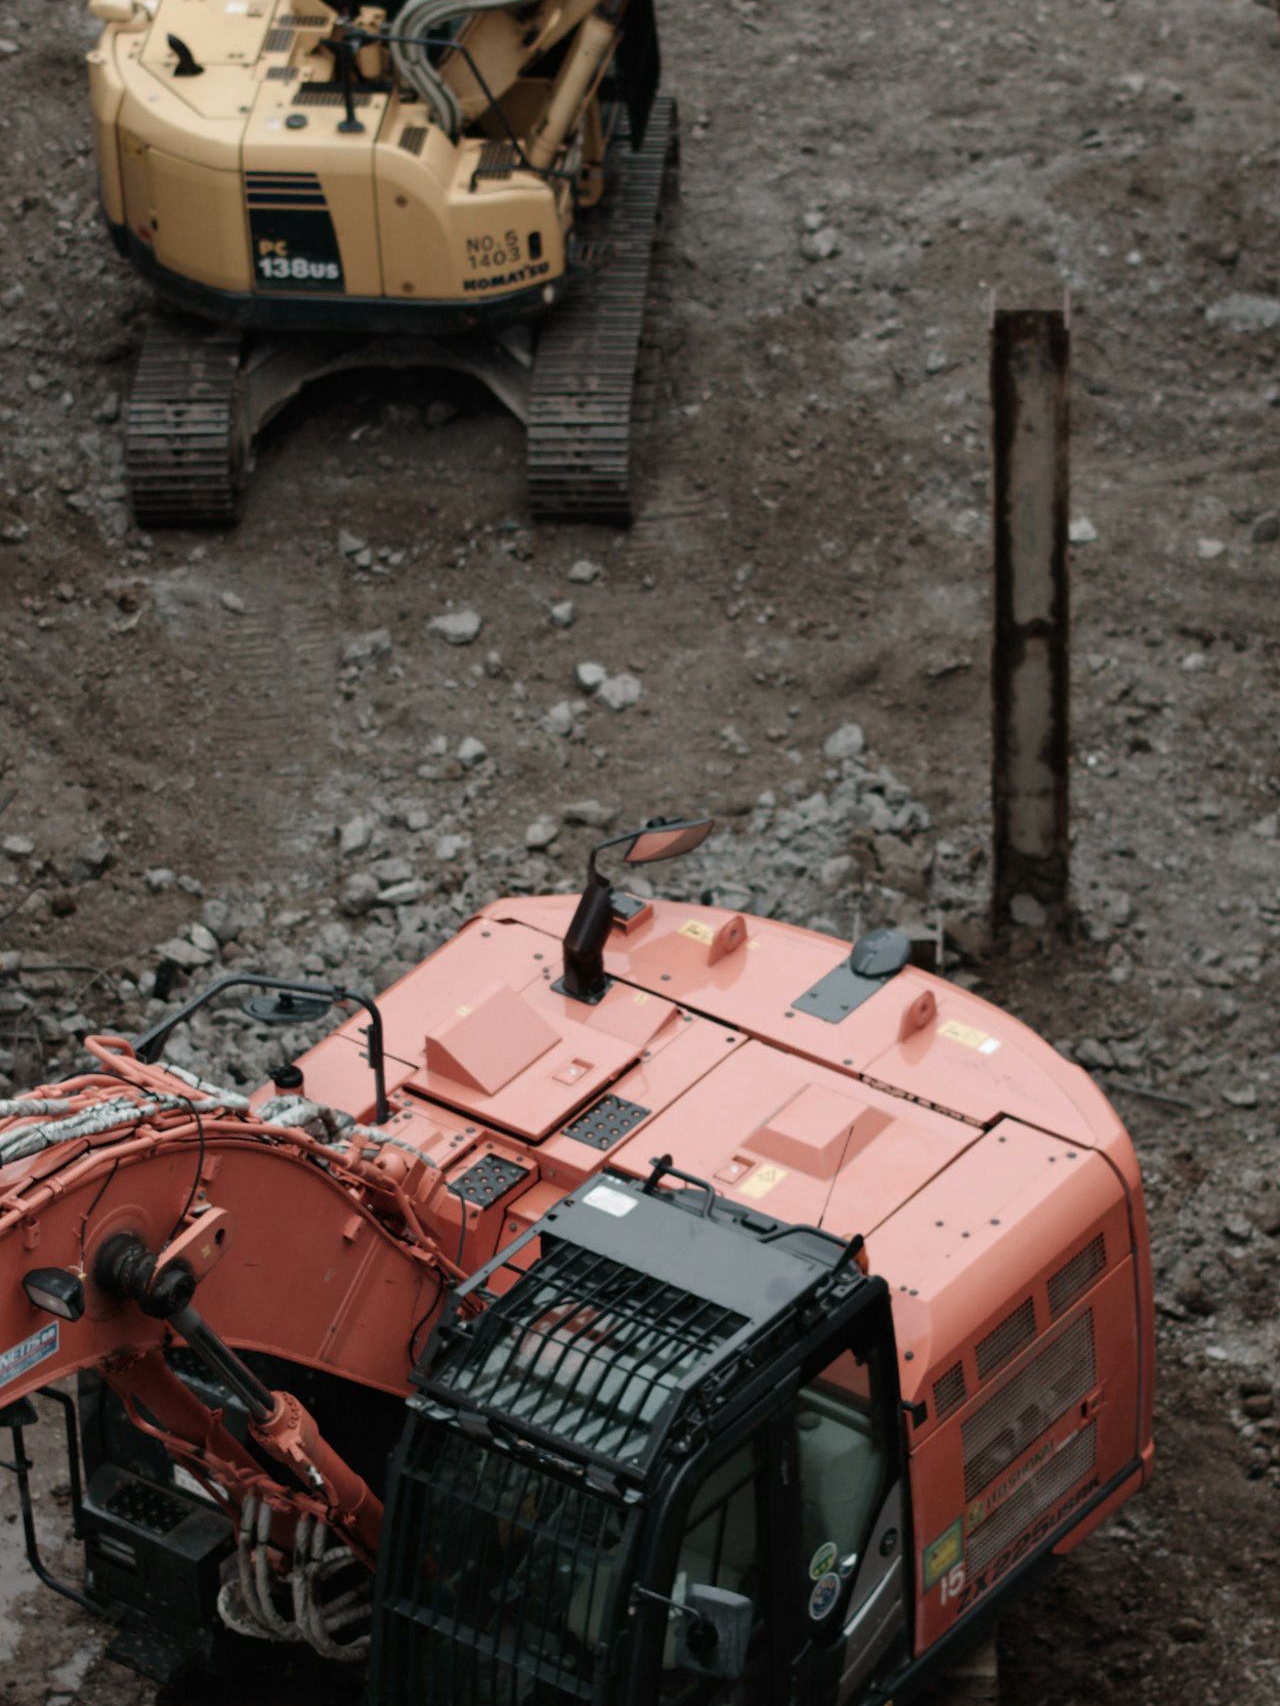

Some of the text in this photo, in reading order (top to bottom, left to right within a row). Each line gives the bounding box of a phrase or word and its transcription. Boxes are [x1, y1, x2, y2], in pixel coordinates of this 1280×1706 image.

[258, 240, 288, 257] PC
[468, 246, 522, 271] 1403
[463, 261, 551, 293] KOMATSU
